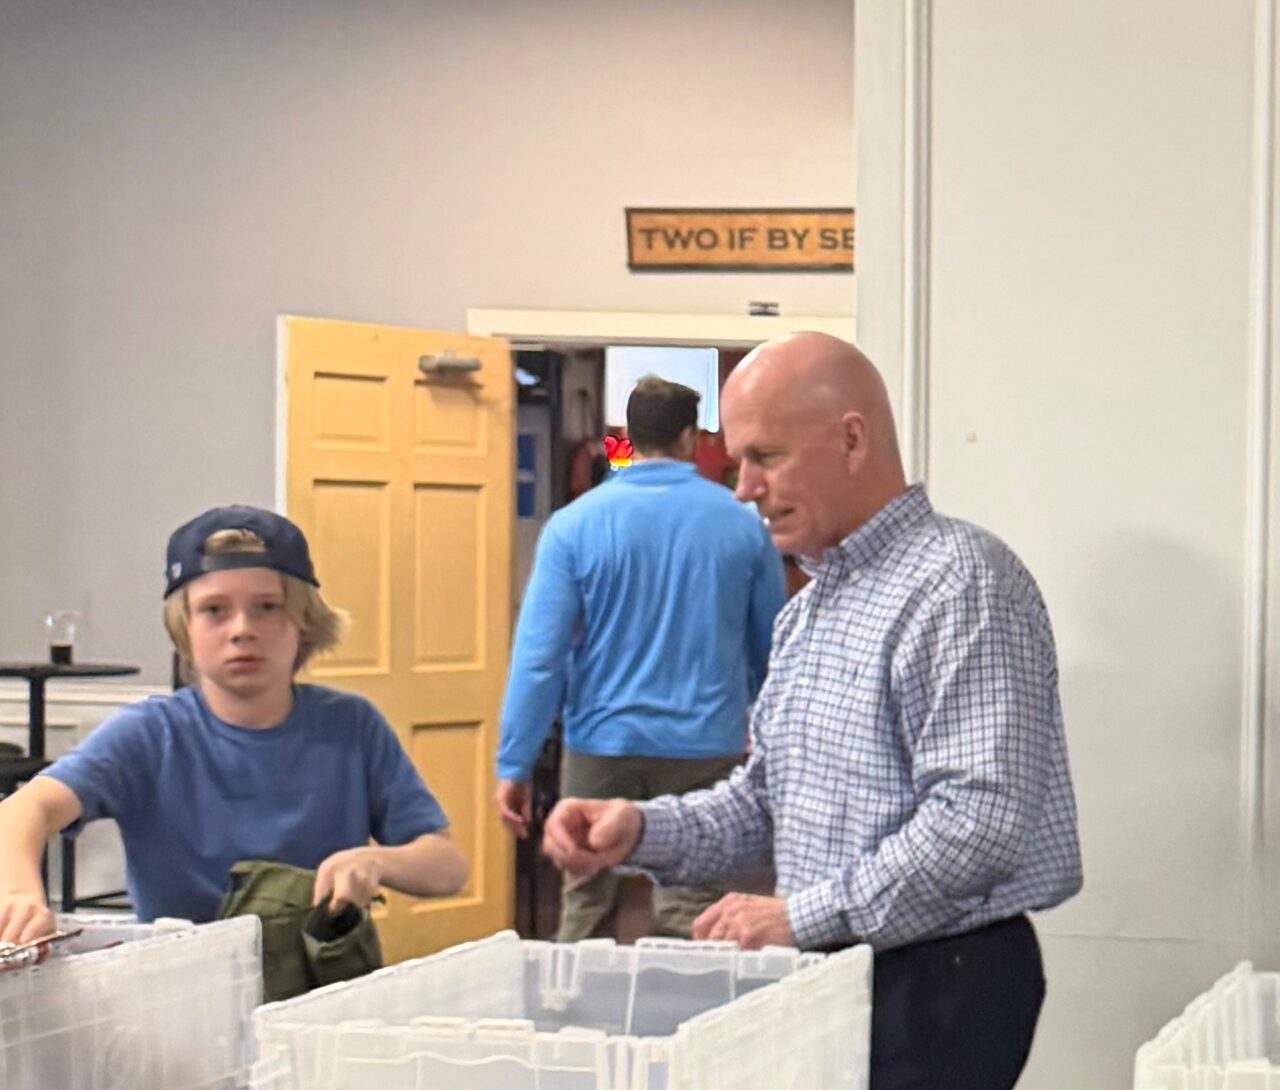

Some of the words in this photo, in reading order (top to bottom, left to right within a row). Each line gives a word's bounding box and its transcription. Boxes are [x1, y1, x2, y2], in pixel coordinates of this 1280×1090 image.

[639, 228, 719, 250] TWO
[728, 228, 758, 250] IF
[767, 227, 810, 250] BY
